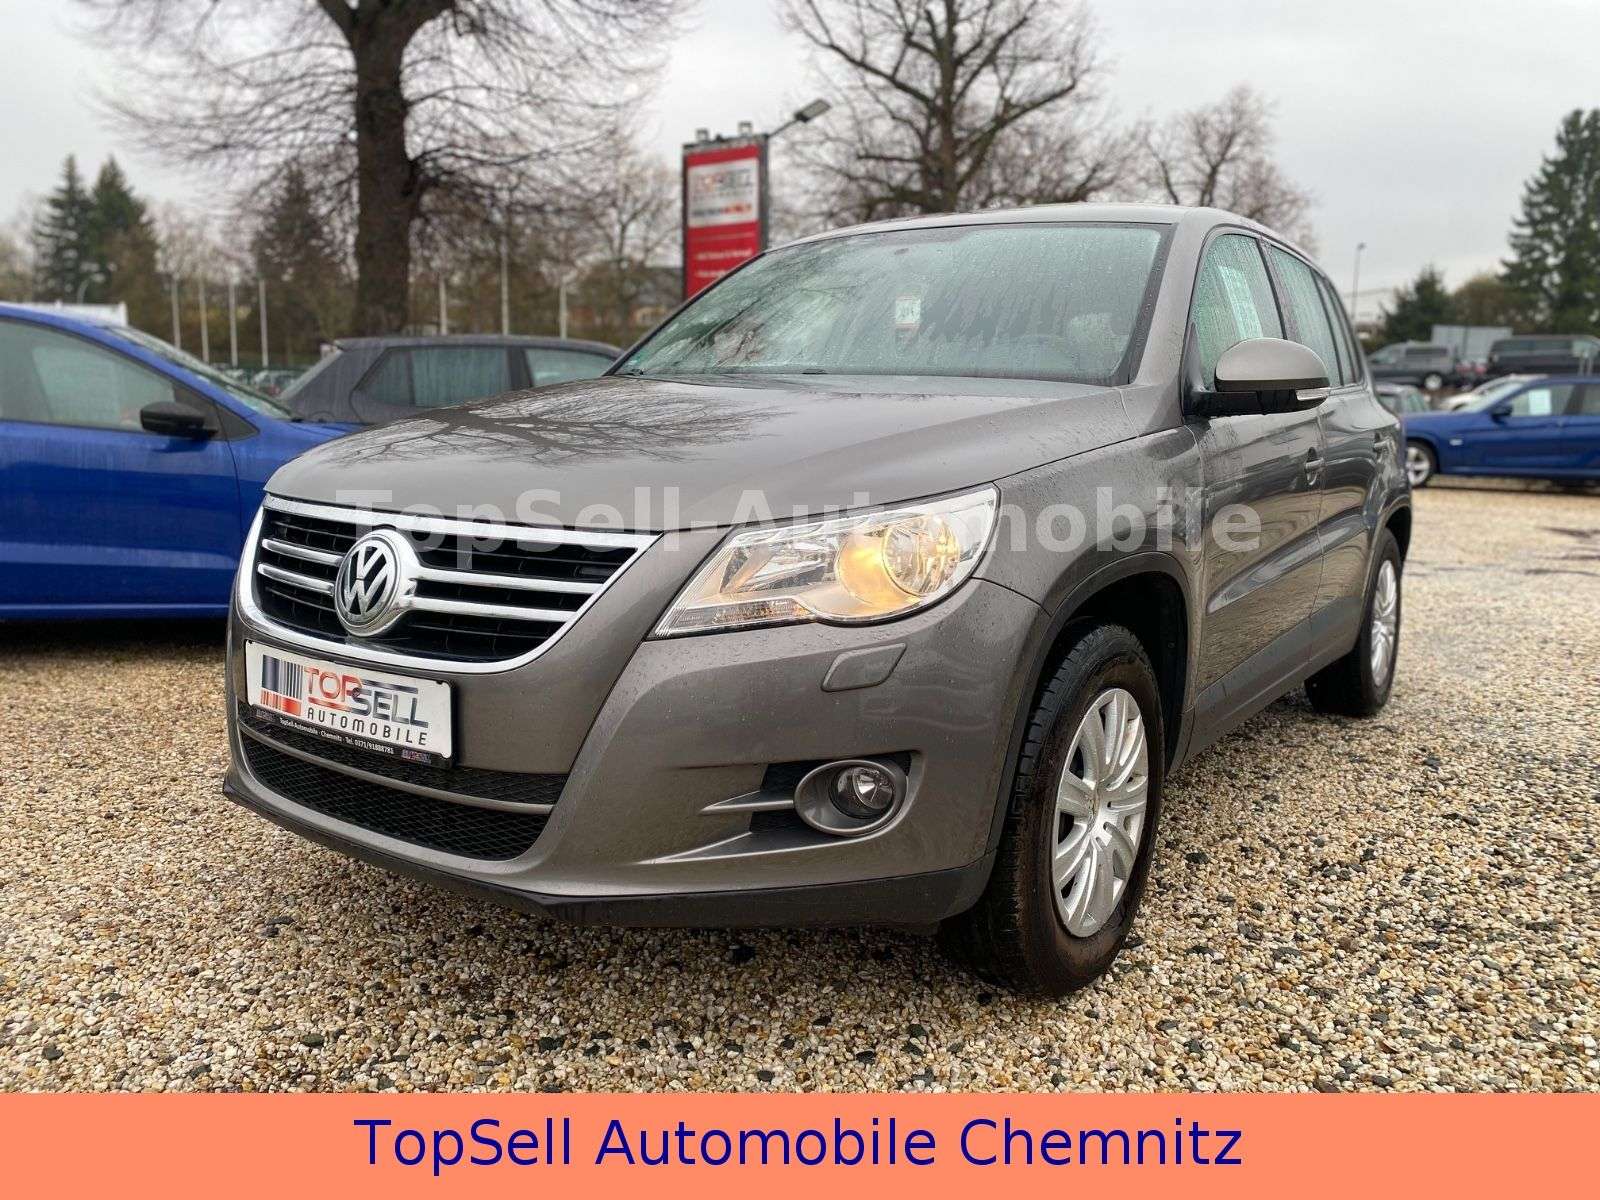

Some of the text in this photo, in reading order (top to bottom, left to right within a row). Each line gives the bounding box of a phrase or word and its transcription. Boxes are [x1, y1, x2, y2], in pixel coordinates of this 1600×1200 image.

[342, 543, 391, 617] VW
[304, 666, 429, 729] TOPSELL
[307, 708, 428, 746] AUTOMOBILE
